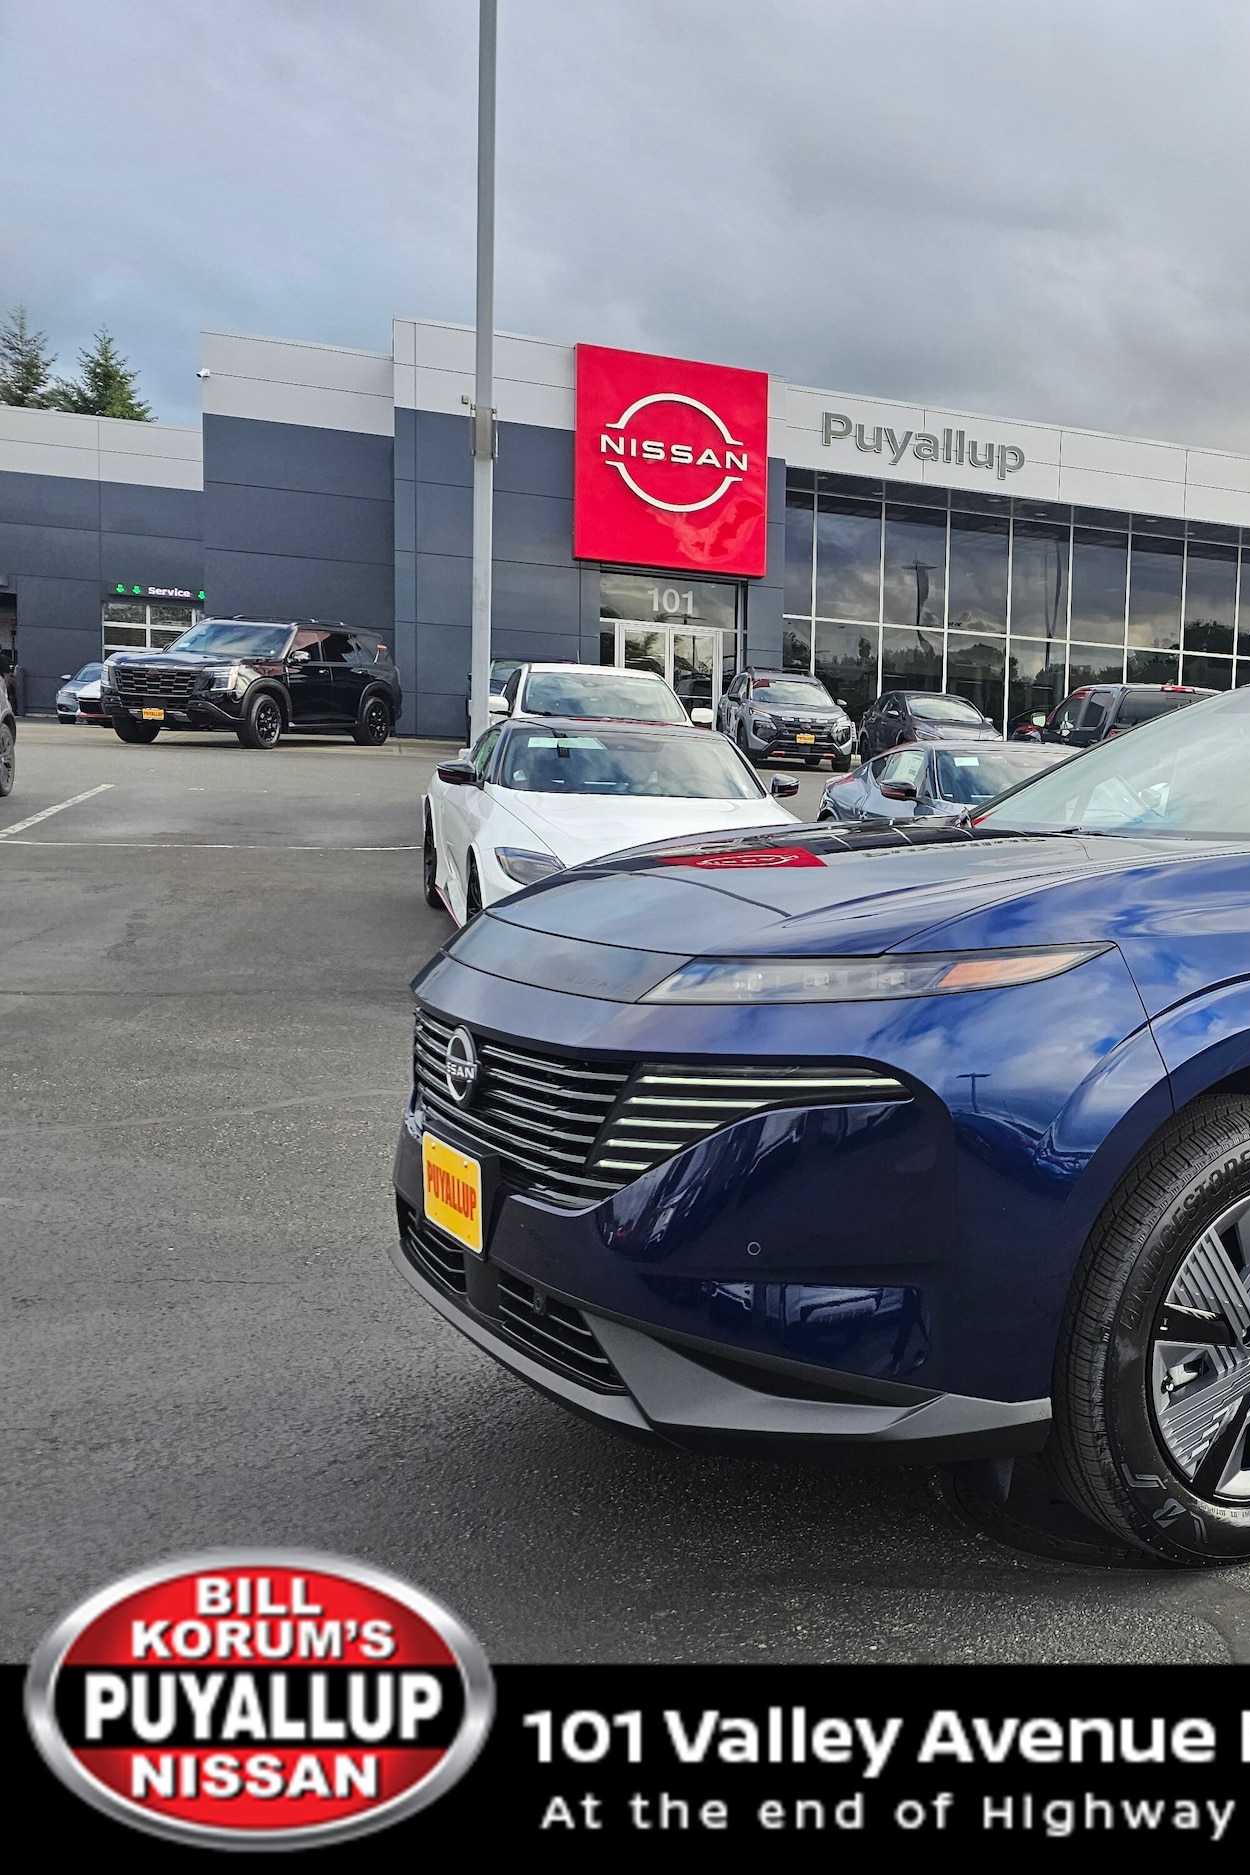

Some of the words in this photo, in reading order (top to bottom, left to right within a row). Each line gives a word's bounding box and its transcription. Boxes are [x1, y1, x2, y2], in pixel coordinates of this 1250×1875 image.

[600, 433, 748, 472] NISSAN
[821, 411, 1026, 480] Puyallup
[148, 587, 191, 598] Service
[647, 587, 693, 614] 101
[426, 1159, 477, 1221] PUYALLUP
